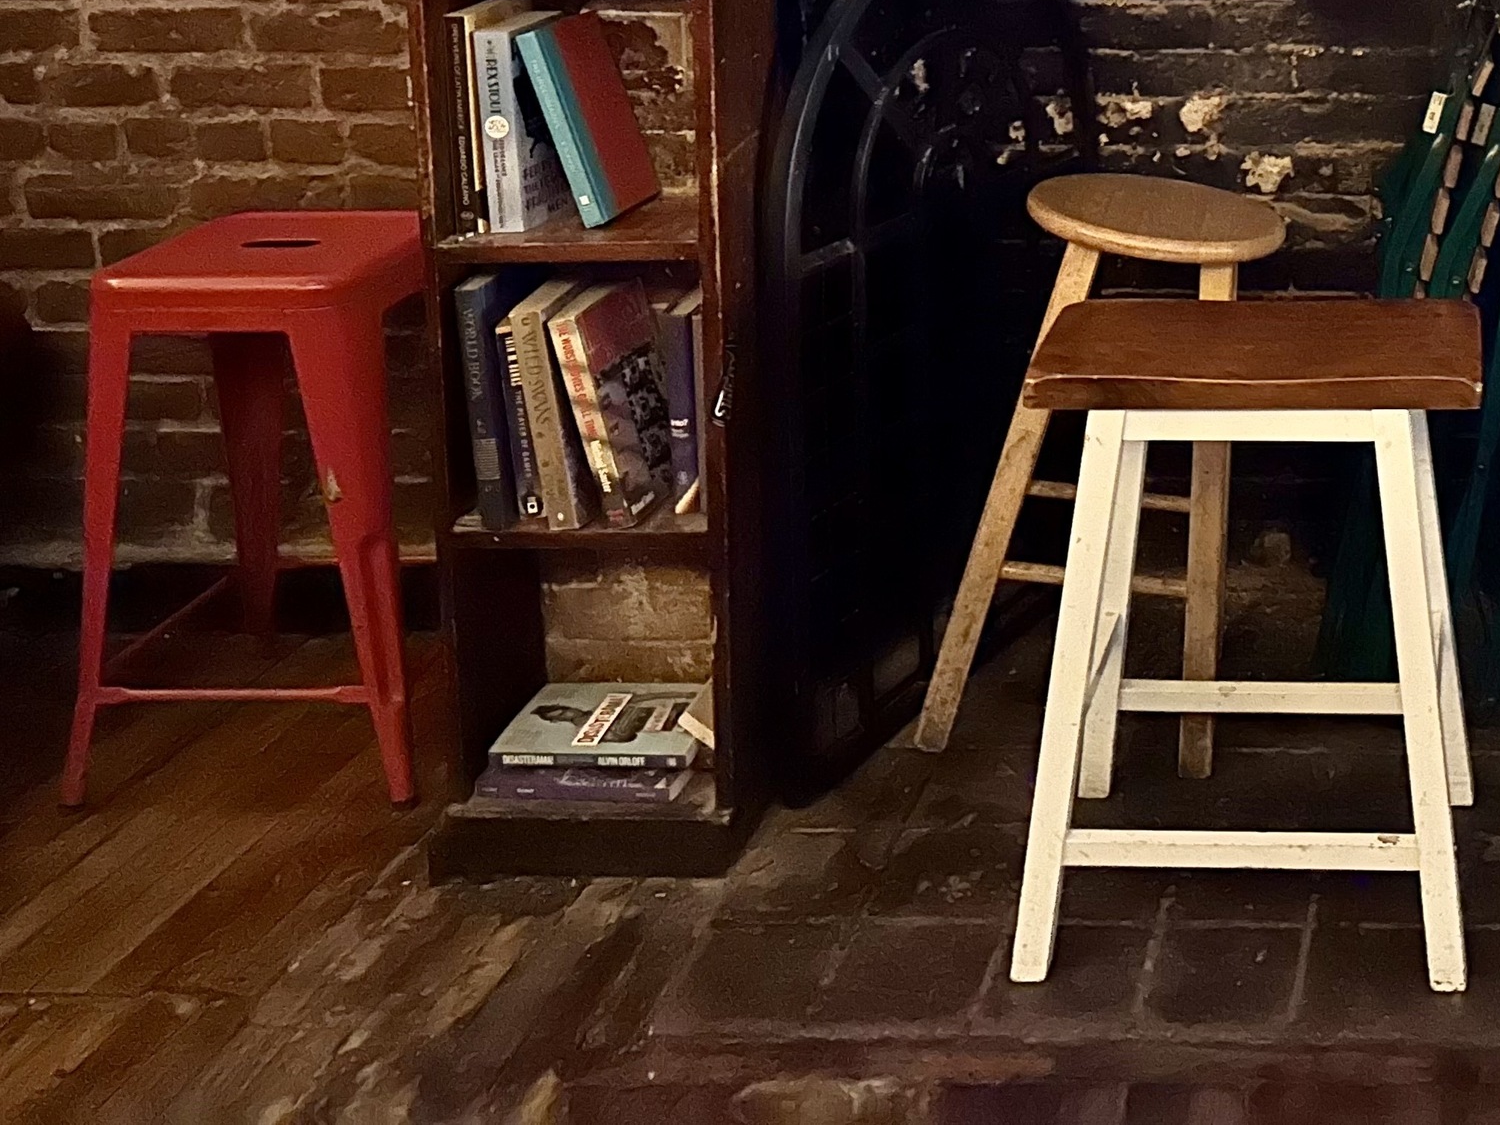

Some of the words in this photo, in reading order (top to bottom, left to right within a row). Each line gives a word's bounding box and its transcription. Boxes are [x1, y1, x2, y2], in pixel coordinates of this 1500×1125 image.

[450, 23, 458, 42] OPEN
[452, 43, 460, 65] VEINS
[485, 58, 498, 79] REX
[454, 76, 462, 97] LATIN
[487, 81, 501, 114] STOUT
[455, 98, 464, 129] AMERICA
[458, 135, 467, 171] EDUARDO
[459, 307, 479, 359] WORLD
[519, 330, 543, 377] WILD
[560, 337, 575, 363] WORST
[466, 361, 483, 400] BOOK
[514, 390, 522, 404] THE
[516, 407, 526, 436] PLAYER
